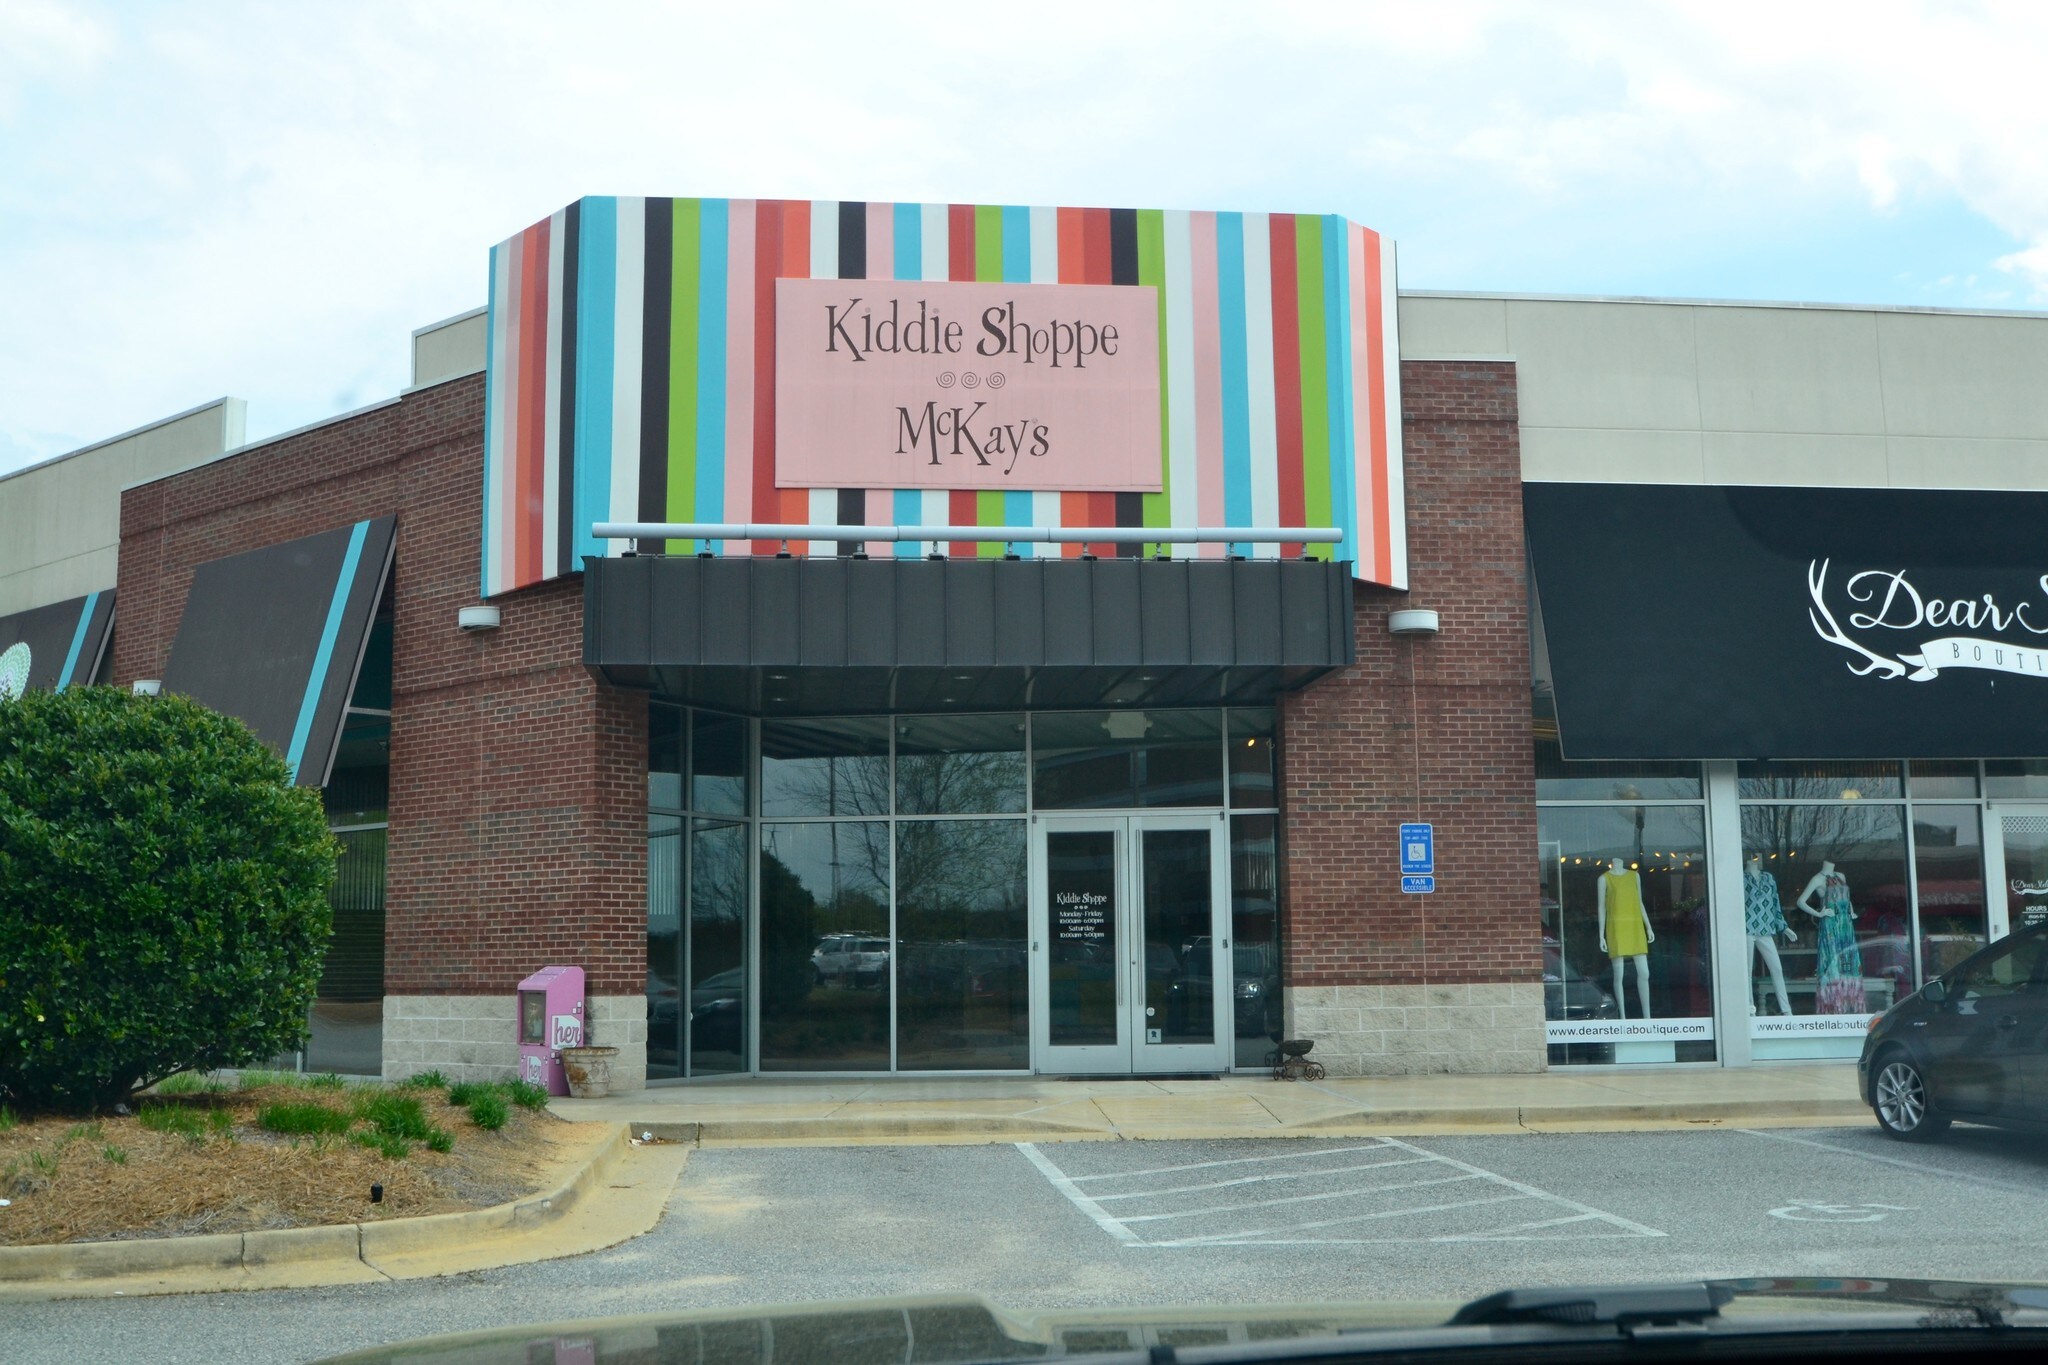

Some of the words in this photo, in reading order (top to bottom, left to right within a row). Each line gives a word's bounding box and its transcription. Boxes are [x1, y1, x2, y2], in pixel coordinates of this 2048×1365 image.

[825, 298, 963, 361] Kiddie
[976, 301, 1119, 368] Shoppe
[895, 401, 1049, 475] McKay's
[1847, 569, 2014, 631] Dear
[1056, 892, 1081, 905] Kiddie
[1081, 891, 1107, 905] Shoppe
[554, 1017, 582, 1046] her
[1548, 1024, 1705, 1037] www.dearstellaboutique.com
